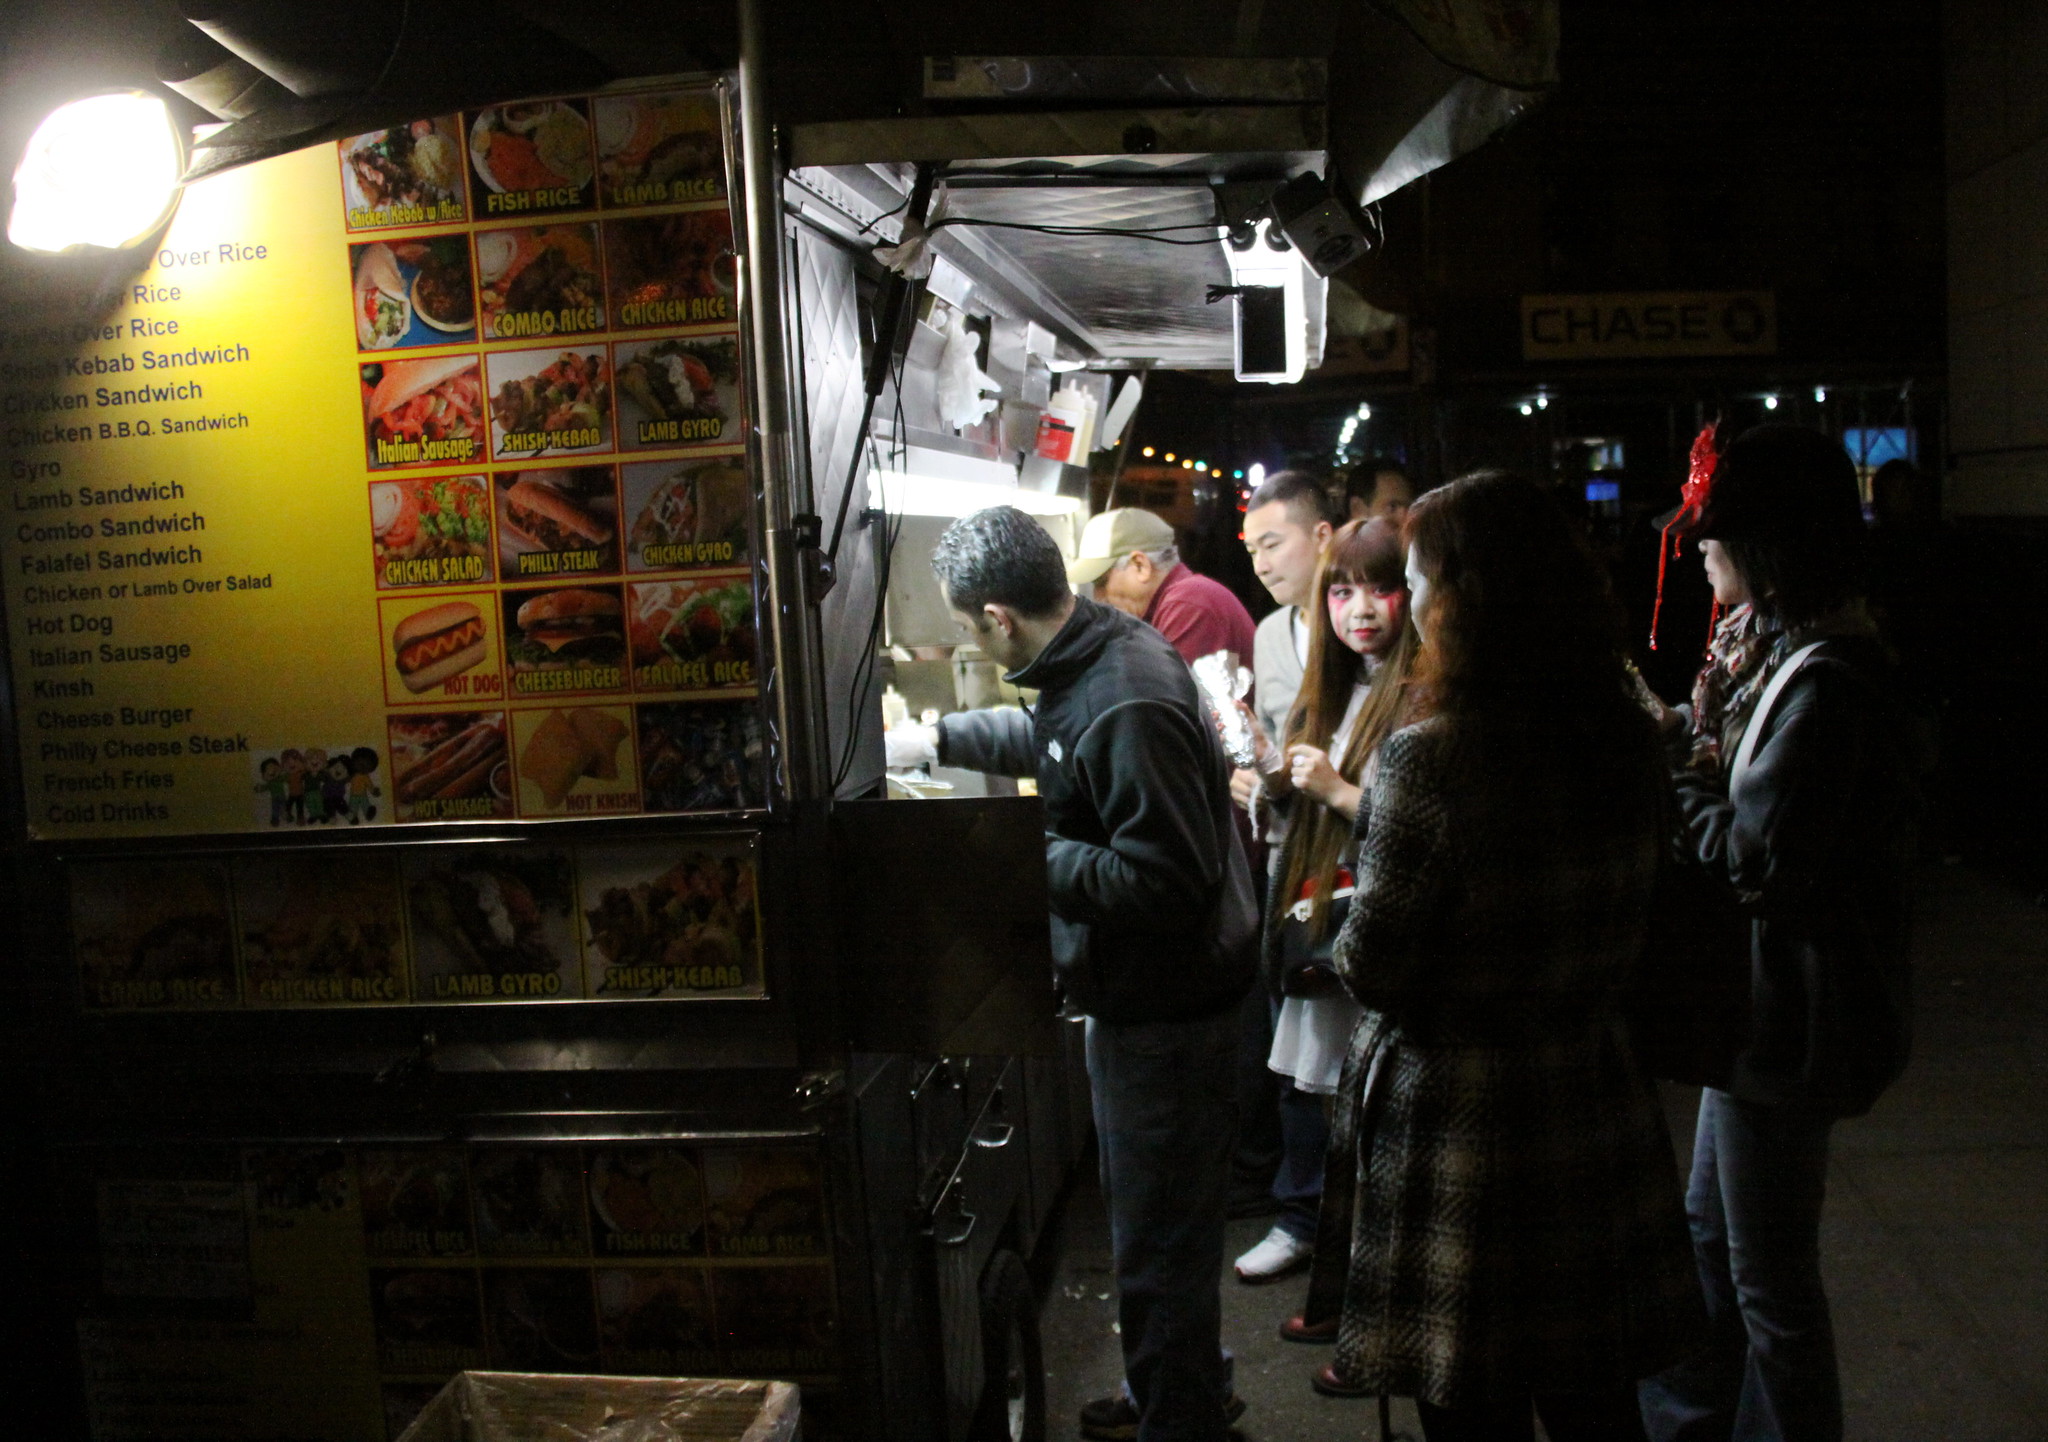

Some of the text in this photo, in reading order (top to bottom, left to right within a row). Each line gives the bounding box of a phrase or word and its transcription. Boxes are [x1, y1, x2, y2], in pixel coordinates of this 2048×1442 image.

[486, 186, 582, 212] FISH RICE
[612, 178, 716, 202] LAMB RICE
[350, 206, 389, 229] Chicken
[390, 202, 424, 226] Kebab
[158, 243, 268, 268] Over Rice
[133, 284, 181, 304] Rice
[492, 305, 596, 338] COMBO RICE
[621, 294, 727, 326] CHICKEN RICE
[72, 321, 123, 343] Over
[131, 318, 179, 338] Rice
[1530, 303, 1709, 344] CHASE
[66, 353, 135, 376] Kebab
[142, 343, 250, 370] Sandwich
[5, 381, 203, 415] Chicken Sandwich
[9, 413, 249, 446] Chicken B.B.Q. Sandwich
[638, 417, 721, 443] LAMB GYRO
[377, 437, 475, 464] Italian Sausage
[11, 459, 61, 483] Gyro
[15, 481, 185, 512] Lamb Sandwich
[17, 512, 206, 544] Combo Sandwich
[22, 545, 202, 576] Falafel Sandwich
[518, 549, 600, 574] PHILLY STEAK
[642, 541, 733, 567] CHICKEN GYRO
[385, 555, 485, 585] CHICKEN SALAD
[25, 573, 272, 604] Chicken or Lamb Over Salad
[28, 614, 113, 635] Hot Dog
[30, 642, 191, 668] Italian Sausage
[444, 673, 500, 696] HOT DOG
[515, 666, 622, 693] CHEESEBURGER
[642, 660, 752, 686] FALAFEL RICE
[34, 678, 94, 699] Kinsh
[37, 707, 194, 731] Cheese Burger
[41, 733, 250, 764] Philly Cheese Steak
[44, 770, 175, 793] French Fries
[50, 801, 169, 824] Cold Drinks
[414, 796, 494, 819] HOT SAUSAGE
[566, 795, 594, 811] HOT
[259, 976, 396, 1001] CHICKEN RICE
[433, 972, 561, 995] LAMB GYRO
[606, 1234, 647, 1252] FISH
[650, 1232, 691, 1250] RICE
